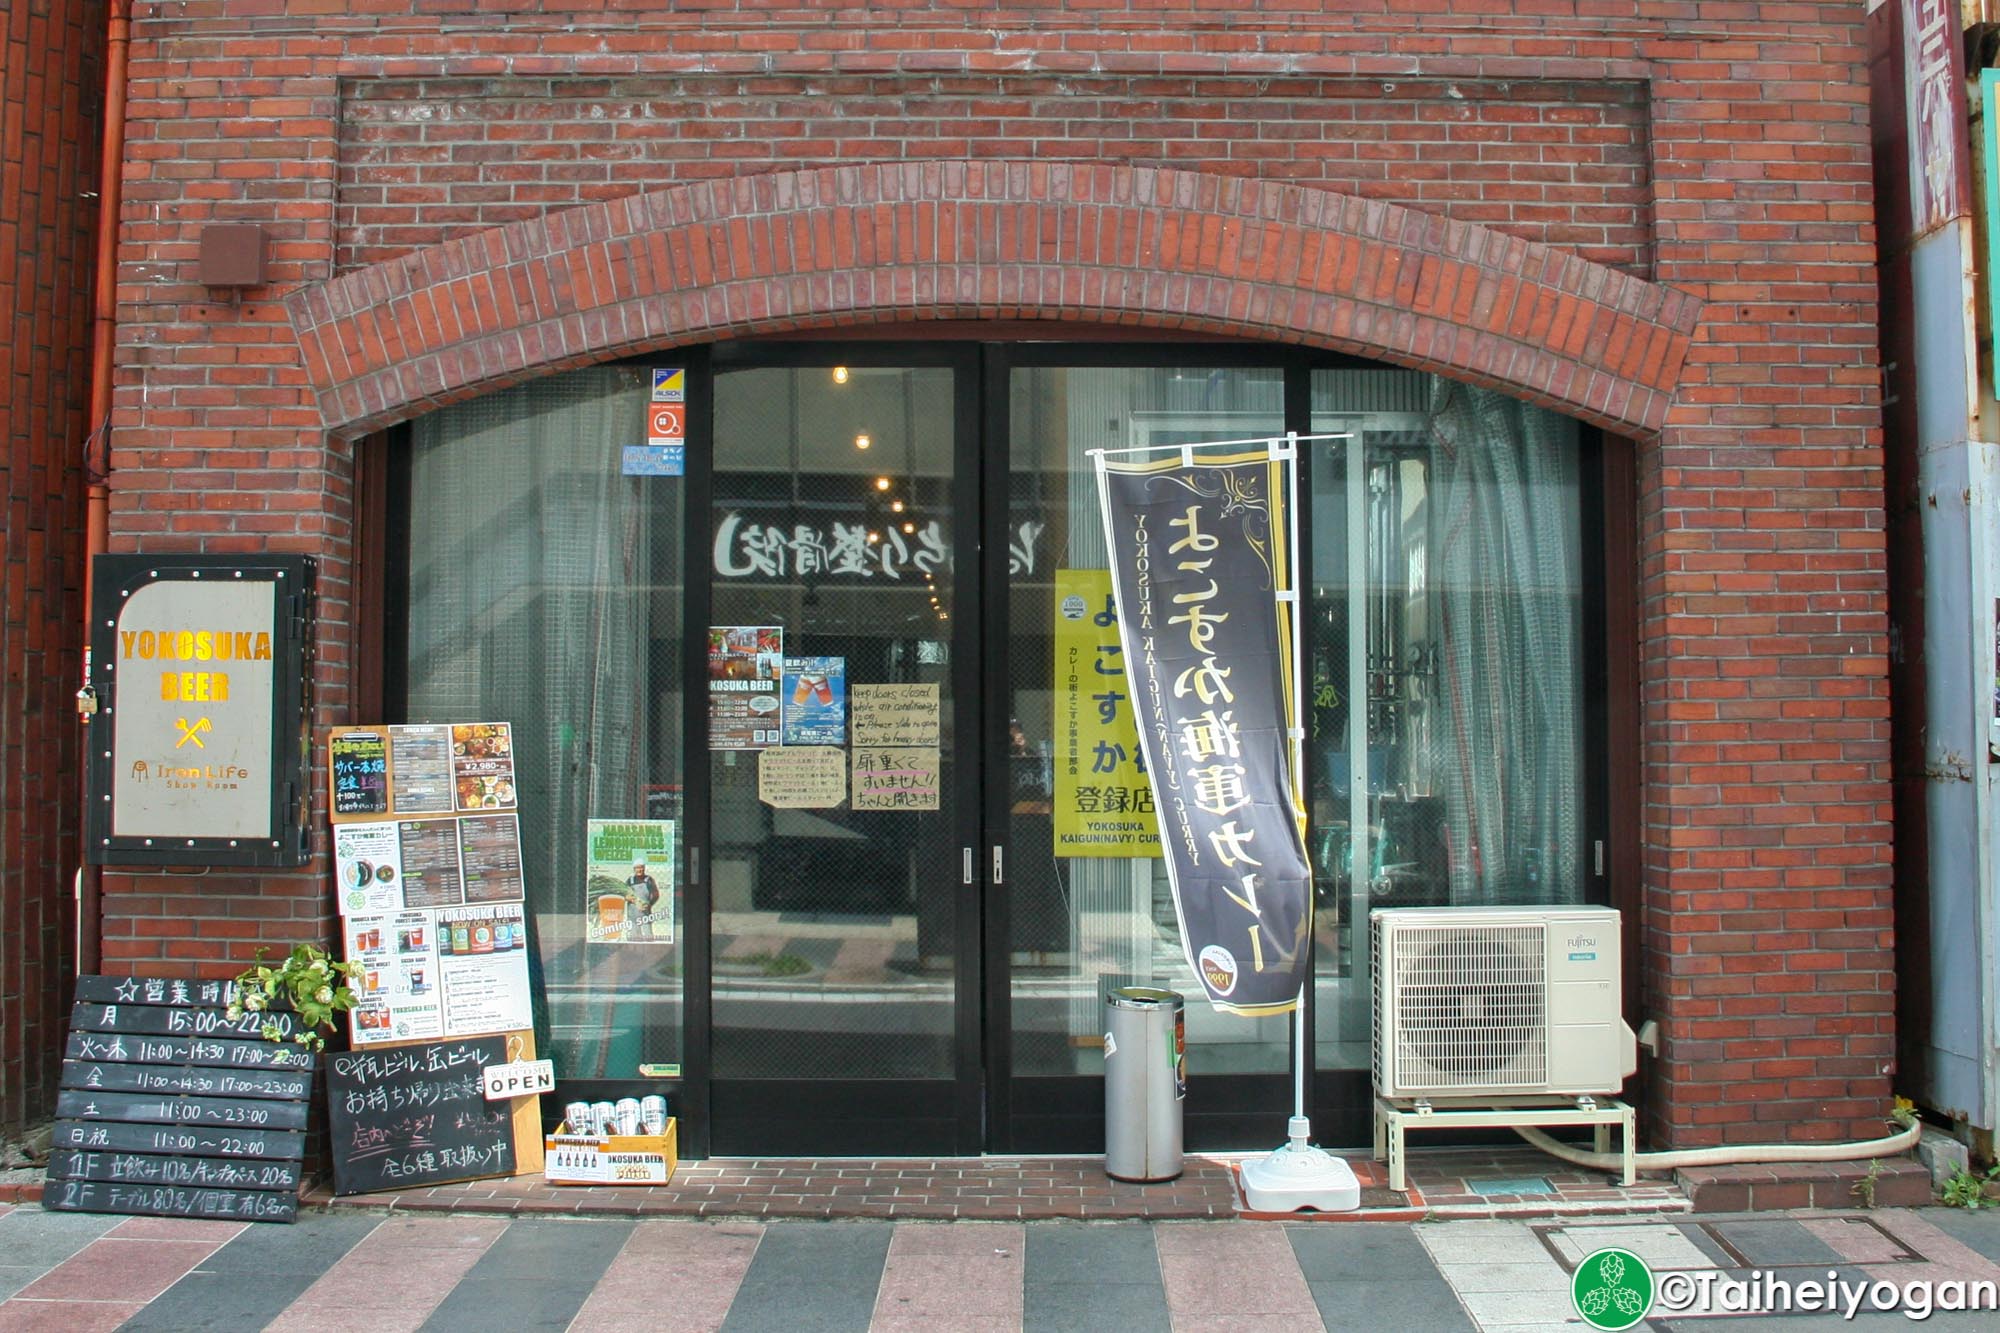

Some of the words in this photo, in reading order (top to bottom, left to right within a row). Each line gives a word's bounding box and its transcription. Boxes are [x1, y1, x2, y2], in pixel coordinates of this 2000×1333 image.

[121, 631, 272, 661] YOKOSUKA
[160, 672, 230, 702] BEER
[750, 680, 774, 691] BEER
[157, 764, 201, 778] Iron
[1075, 786, 1156, 814] 登録店
[1087, 822, 1145, 831] YOKOSUKA
[437, 907, 495, 922] YOKOSUKA
[496, 905, 521, 918] BEER
[591, 919, 633, 938] Coming
[1567, 937, 1596, 948] FUJITSU
[100, 1005, 118, 1026] 月
[491, 1074, 549, 1092] OPEN
[84, 1101, 100, 1115] 土
[644, 1154, 664, 1163] BEER
